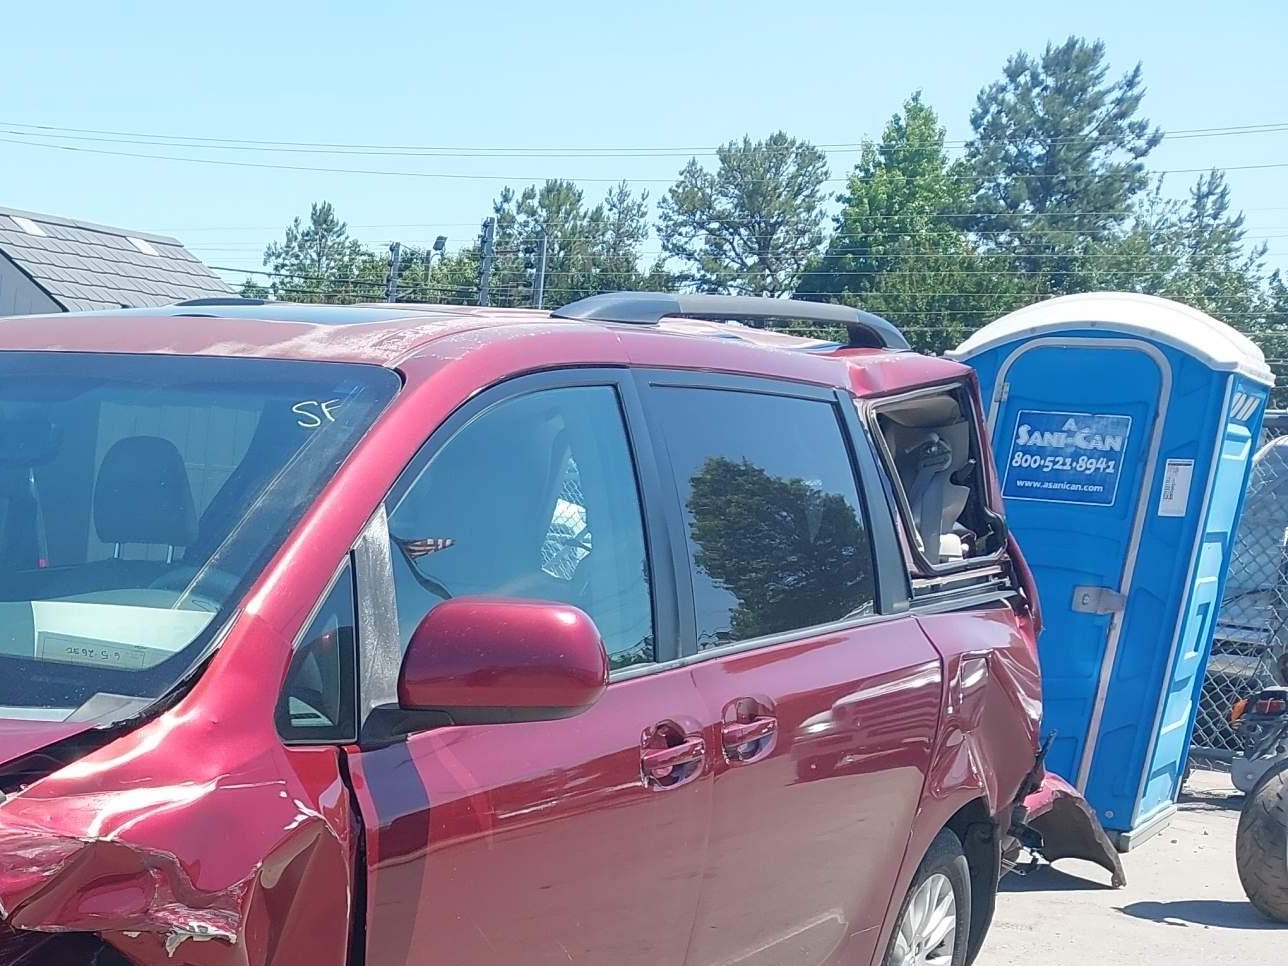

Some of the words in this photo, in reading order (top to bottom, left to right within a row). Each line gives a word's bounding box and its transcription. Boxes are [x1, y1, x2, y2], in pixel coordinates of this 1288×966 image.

[292, 398, 341, 428] SF
[1062, 417, 1078, 431] A
[1016, 480, 1104, 492] www.asanican.com
